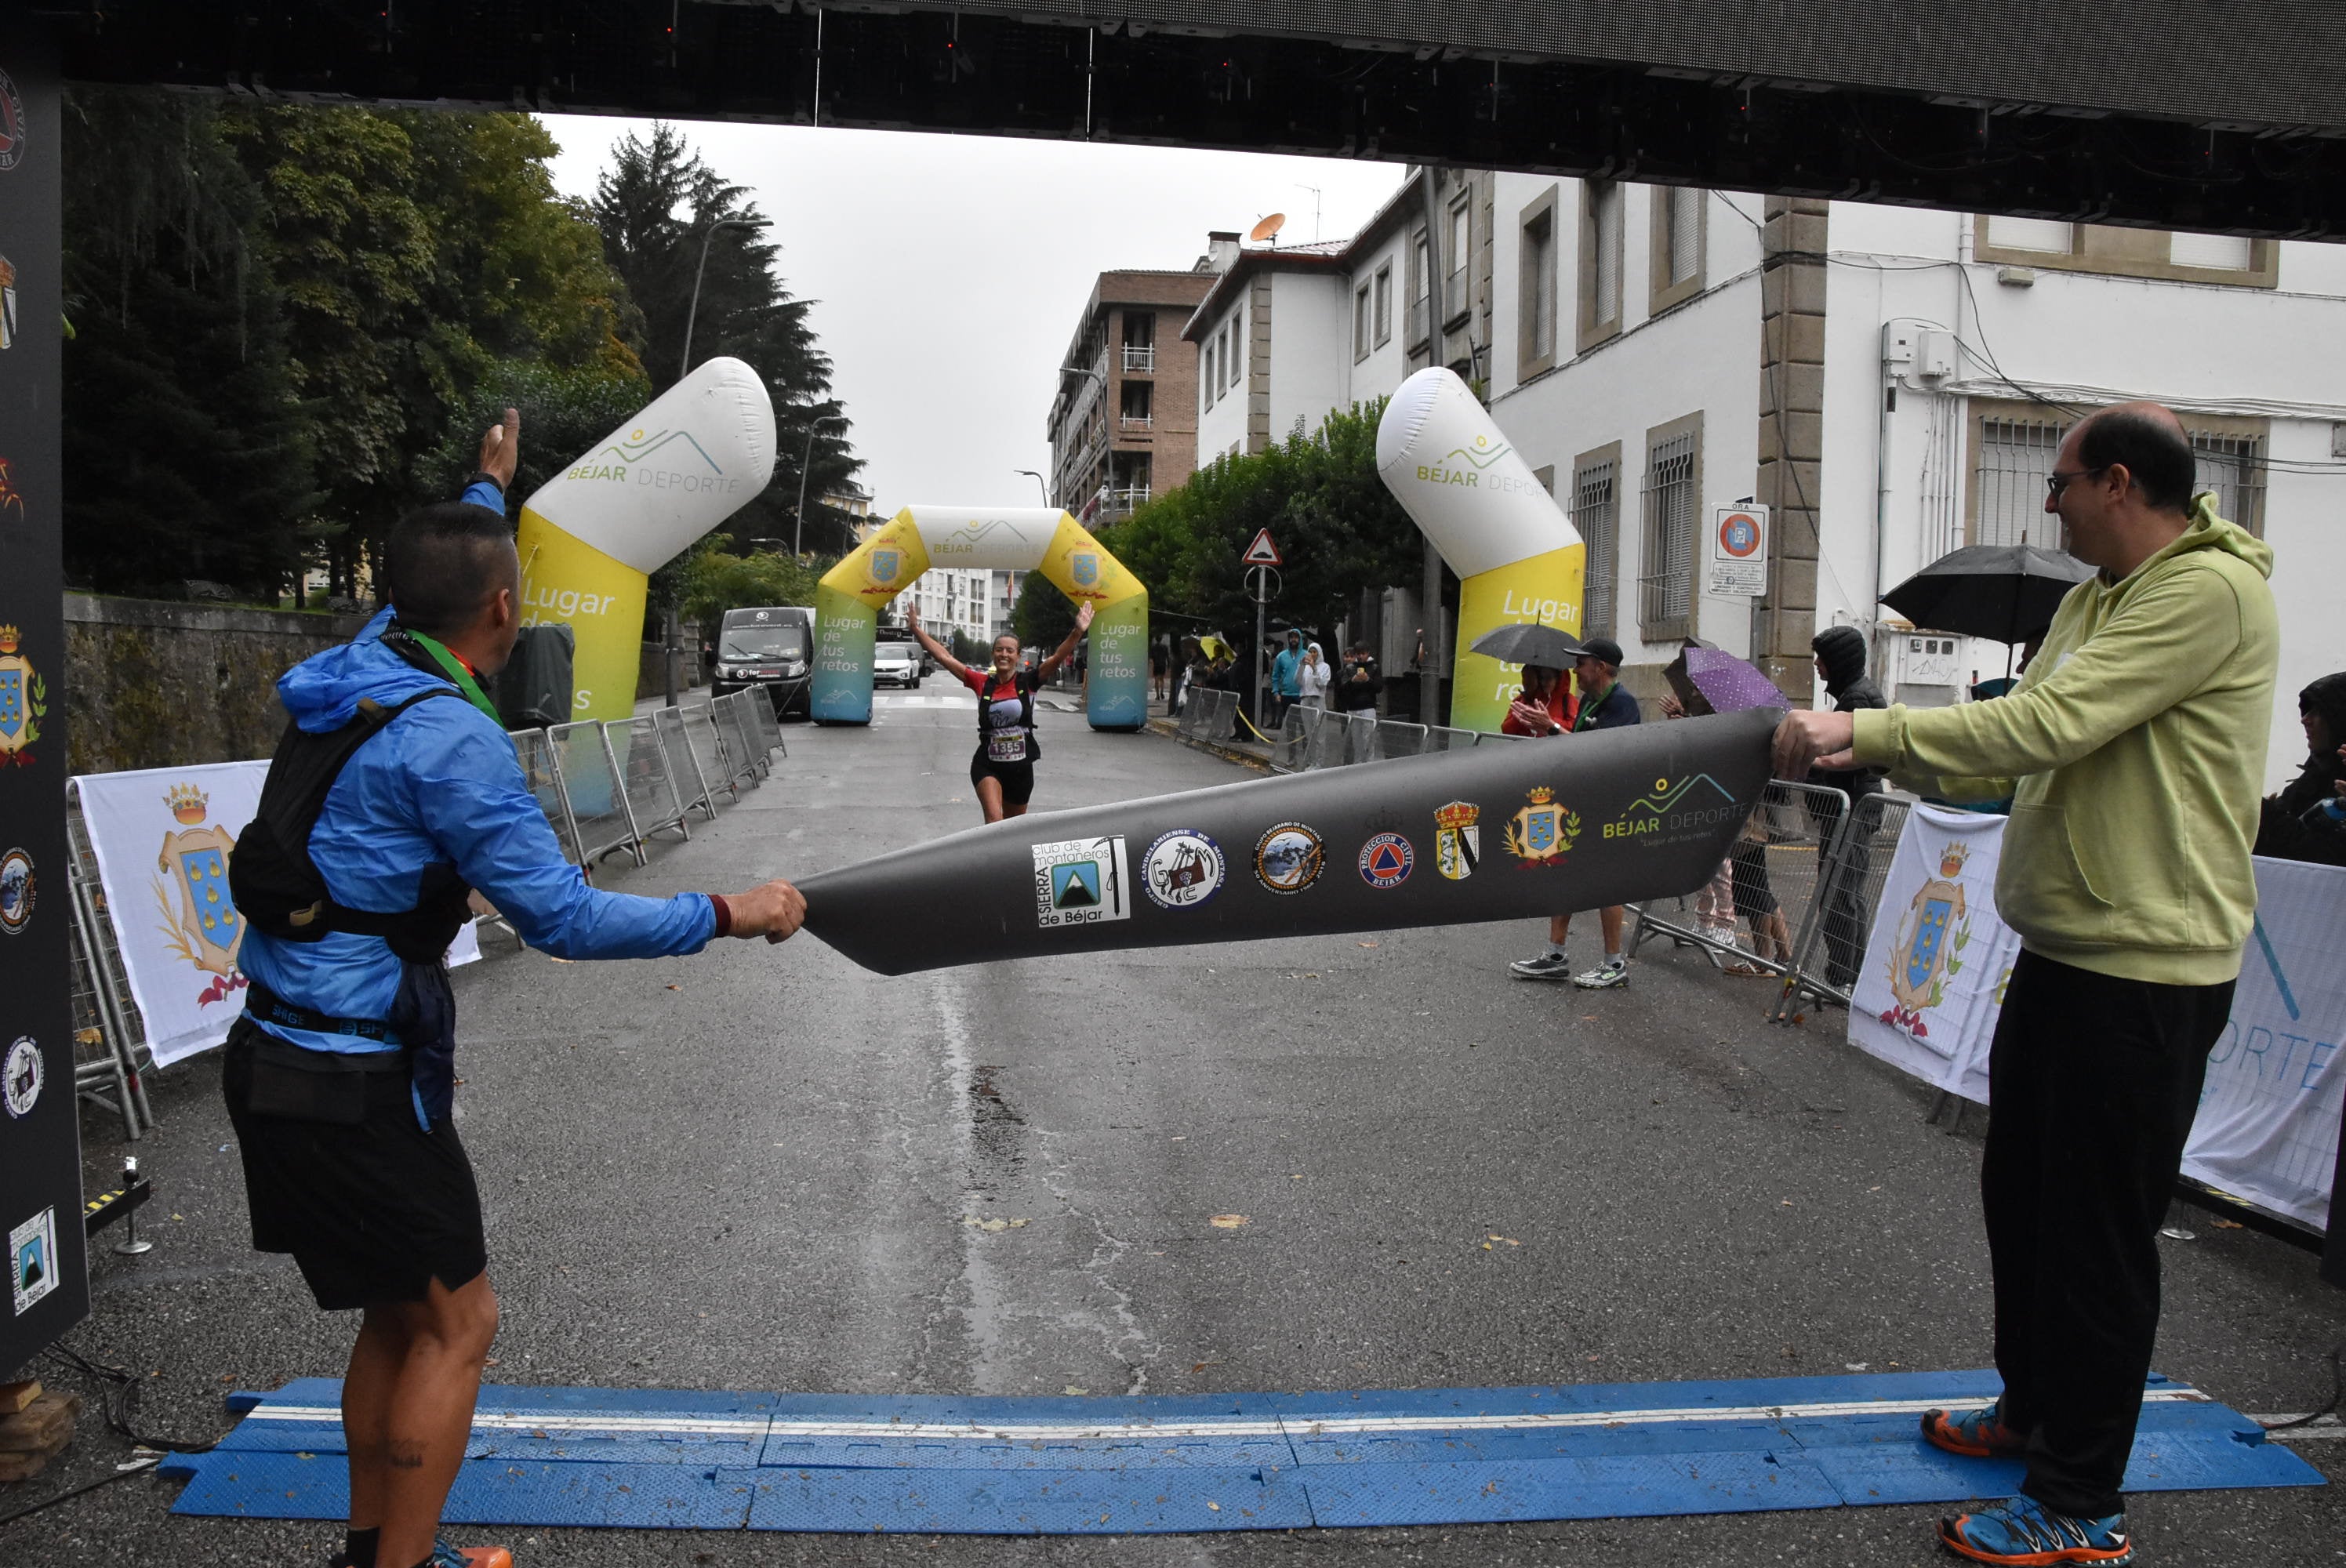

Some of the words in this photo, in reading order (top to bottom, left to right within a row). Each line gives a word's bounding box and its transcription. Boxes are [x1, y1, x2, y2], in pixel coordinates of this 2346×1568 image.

[567, 459, 626, 482] BÉJAR
[638, 469, 740, 494] DEPORTE
[1417, 459, 1478, 487] BÉJAR
[524, 578, 616, 617] Lugar
[1503, 590, 1578, 623] Lugar
[824, 615, 866, 630] Lugar
[1100, 622, 1141, 637] Lugar
[823, 630, 841, 642] de
[1100, 636, 1117, 649] de
[823, 644, 844, 656] tus
[1100, 652, 1122, 664] tus
[822, 659, 859, 672] retos
[1099, 666, 1136, 678] retos
[993, 742, 1020, 753] 1355
[1603, 813, 1659, 838] BÉJAR
[1670, 803, 1748, 829] DEPORTE
[1033, 843, 1060, 855] club
[1064, 840, 1081, 851] de
[1255, 834, 1267, 851] GRUPO
[1034, 849, 1109, 866] montañeros
[1142, 829, 1190, 880] CANDELARIENSE
[1197, 833, 1210, 843] DE
[1361, 836, 1396, 869] PROTECCION
[1400, 842, 1411, 866] CIVIL
[1037, 866, 1051, 914] SIERRA
[1039, 914, 1059, 926] de
[1065, 910, 1102, 923] Béjar
[2207, 1019, 2337, 1091] ORTE
[13, 1251, 21, 1299] SIERRA
[16, 1298, 26, 1312] de
[27, 1284, 45, 1304] Béjar
